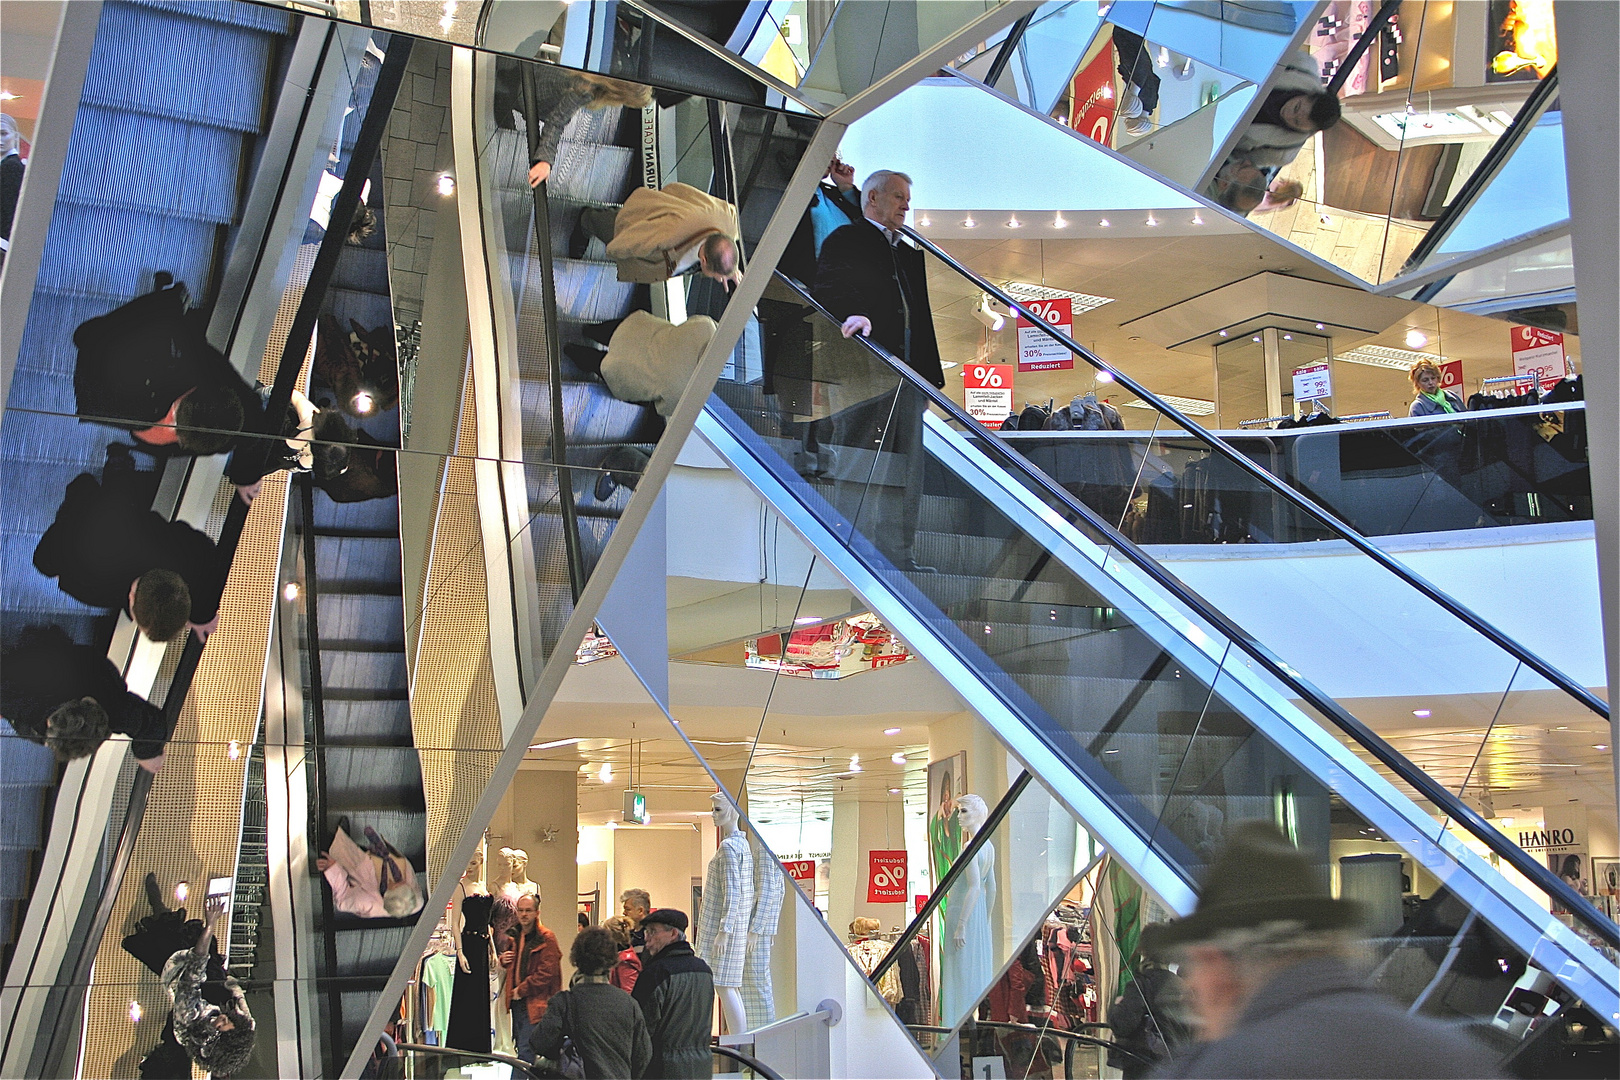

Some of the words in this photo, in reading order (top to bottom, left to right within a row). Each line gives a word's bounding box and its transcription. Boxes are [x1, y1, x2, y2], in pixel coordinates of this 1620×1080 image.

[1028, 302, 1061, 324] %
[1024, 349, 1042, 358] 30%
[974, 367, 1002, 387] %
[1519, 829, 1573, 846] HANRO
